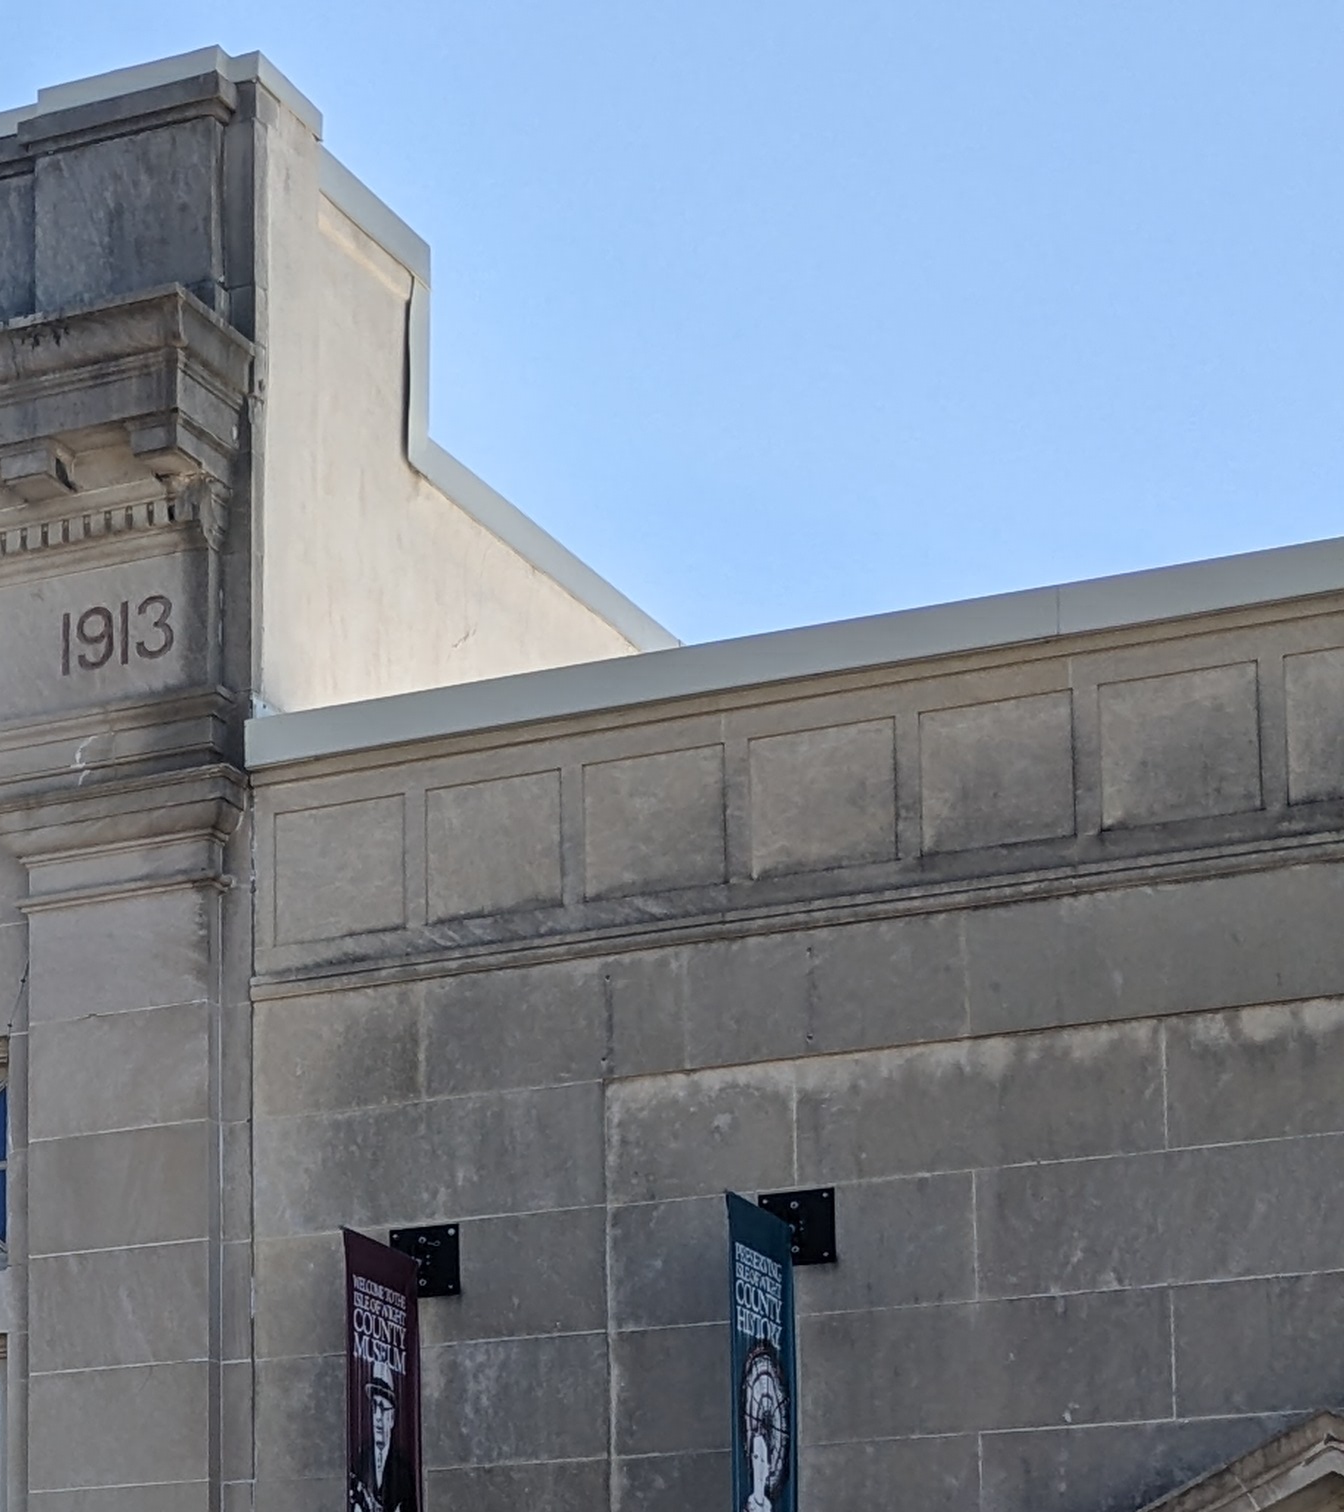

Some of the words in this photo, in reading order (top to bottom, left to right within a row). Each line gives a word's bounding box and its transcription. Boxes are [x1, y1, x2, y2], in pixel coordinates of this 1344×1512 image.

[62, 595, 174, 676] 1913
[736, 1279, 782, 1324] COUNTY
[354, 1308, 407, 1350] COUNTY
[736, 1305, 782, 1350] HISTORY
[353, 1331, 406, 1376] MUSEUM
